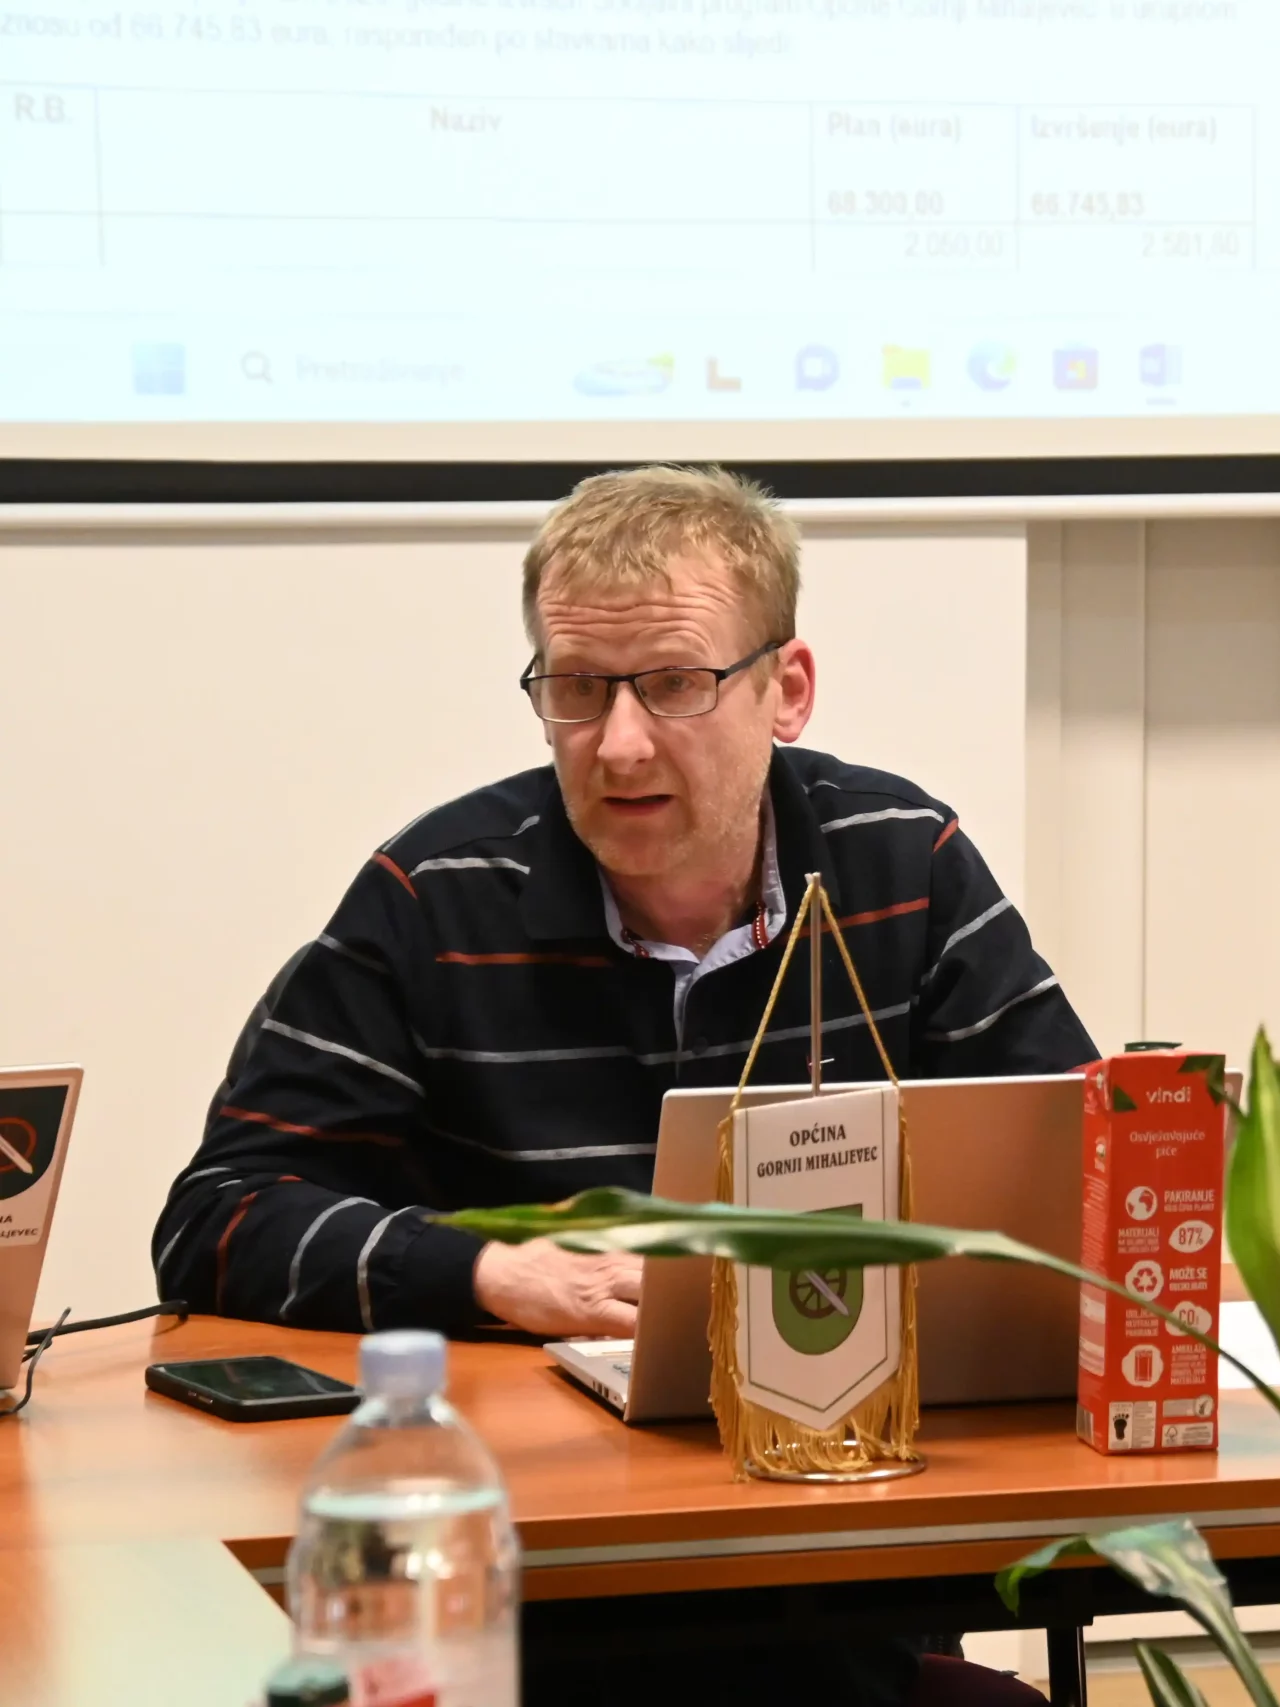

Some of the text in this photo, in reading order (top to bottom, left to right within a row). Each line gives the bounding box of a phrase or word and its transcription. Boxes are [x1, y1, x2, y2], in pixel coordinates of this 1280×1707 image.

[89, 12, 122, 39] od
[658, 28, 716, 55] kako
[430, 106, 502, 133] Naziv
[827, 111, 962, 145] Plan (eura)
[1148, 113, 1218, 145] (eura)
[1146, 1086, 1191, 1103] vindi
[789, 1122, 847, 1147] OPĆINA
[757, 1146, 878, 1178] GORNJI MIHALJEVEC
[1179, 1227, 1203, 1245] 87%
[1197, 1267, 1207, 1279] SE
